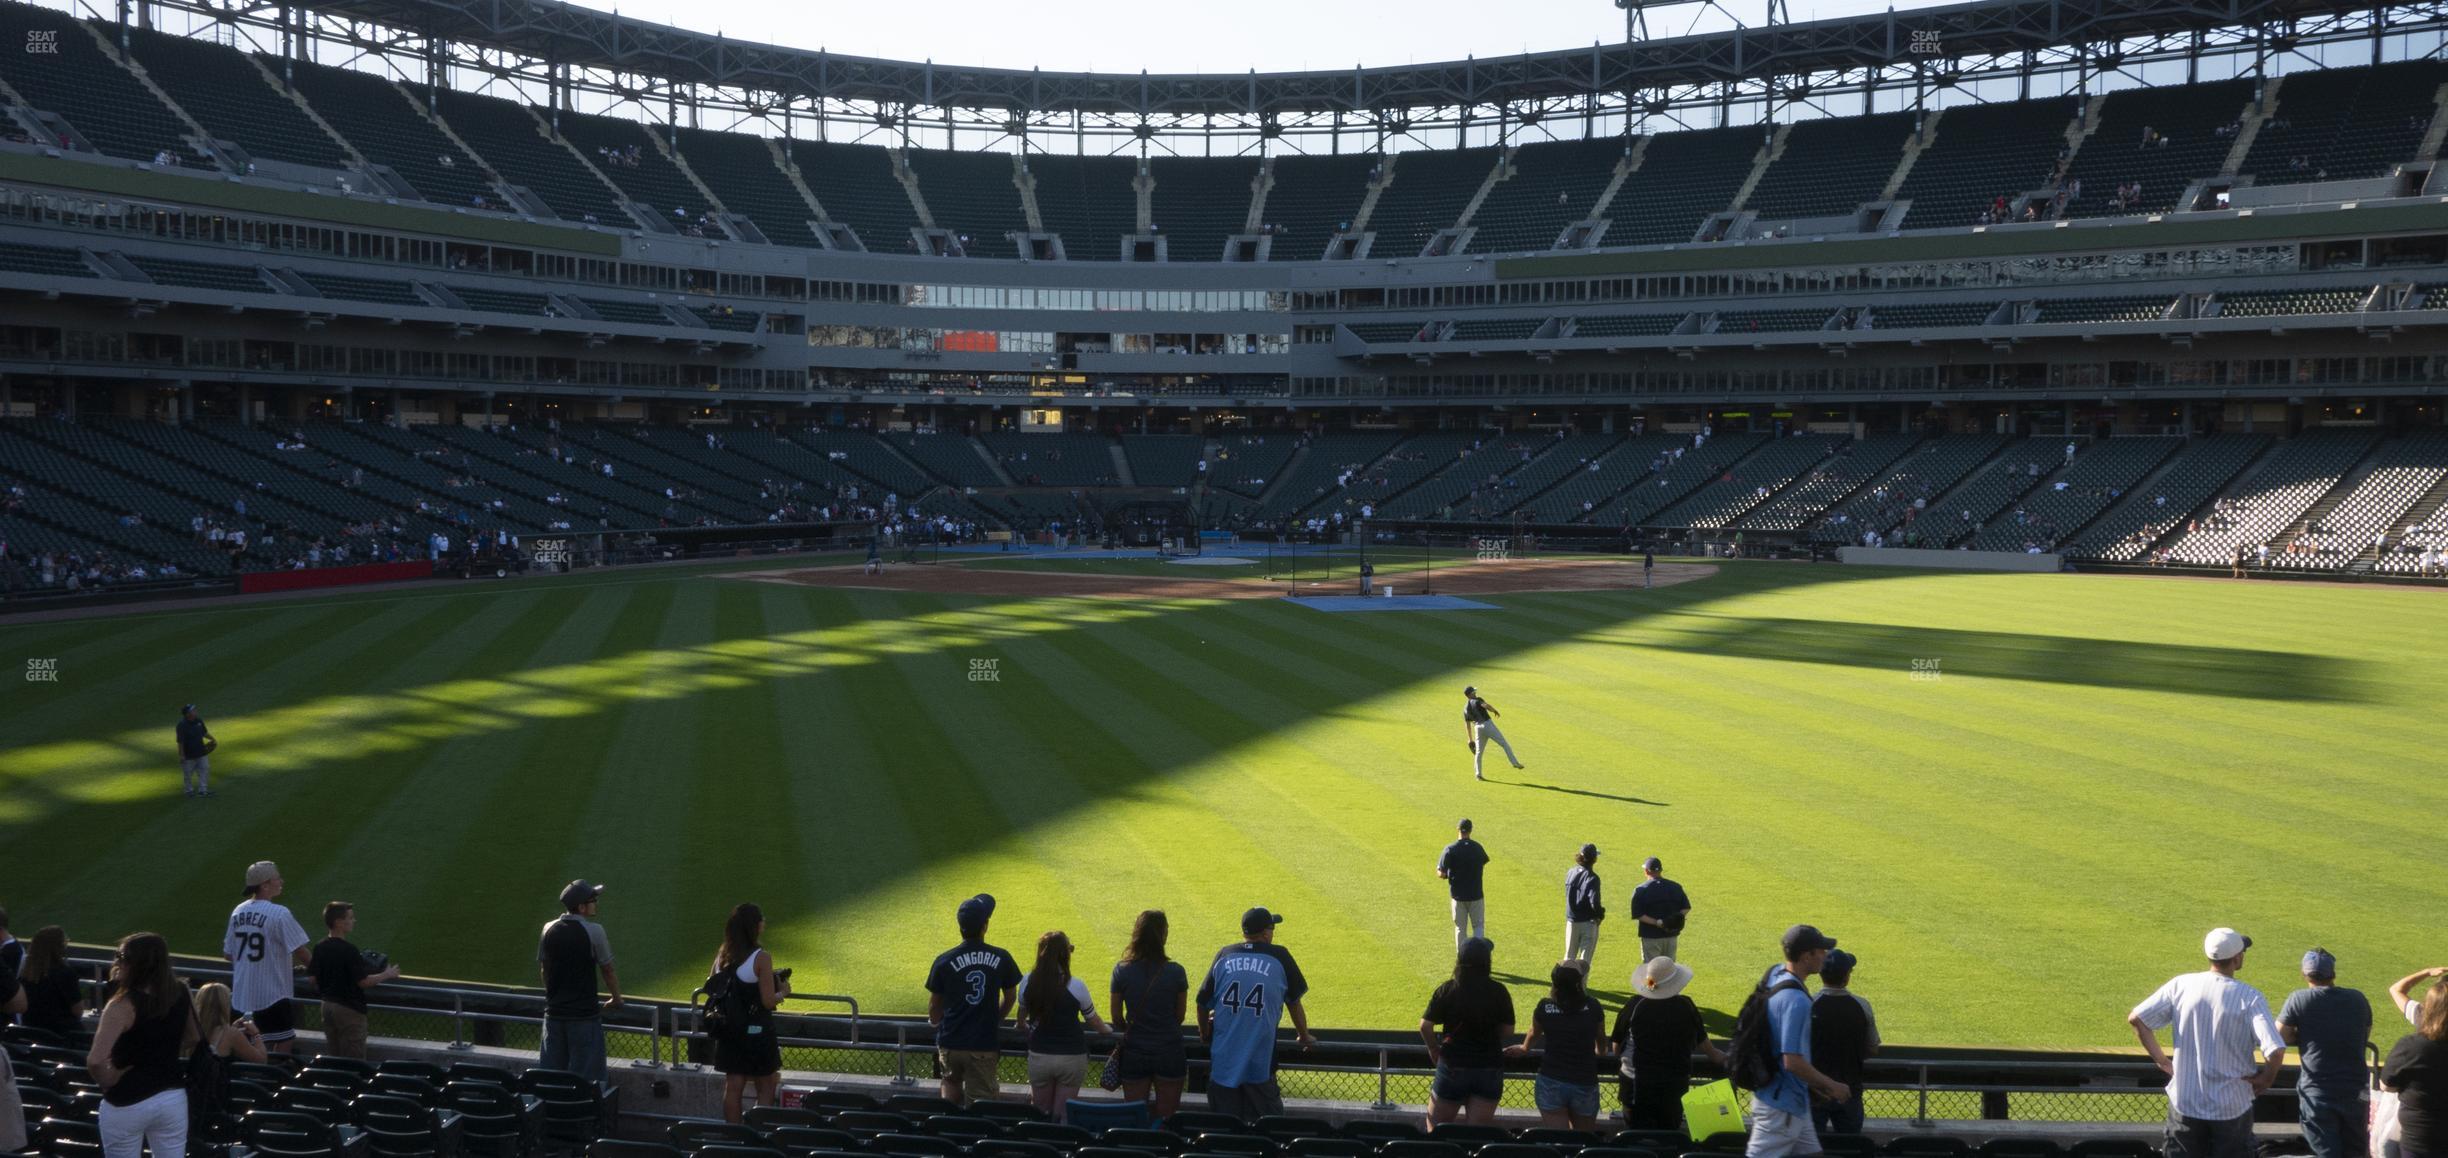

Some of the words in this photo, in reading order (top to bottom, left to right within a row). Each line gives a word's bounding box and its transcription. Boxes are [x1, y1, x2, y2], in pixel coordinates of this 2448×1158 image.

[233, 912, 268, 928] ABREU
[235, 932, 265, 962] 79
[950, 951, 1001, 972] LONGORIA
[1225, 957, 1271, 976] STEGALL
[965, 970, 986, 1005] 3
[1222, 980, 1265, 1017] 44
